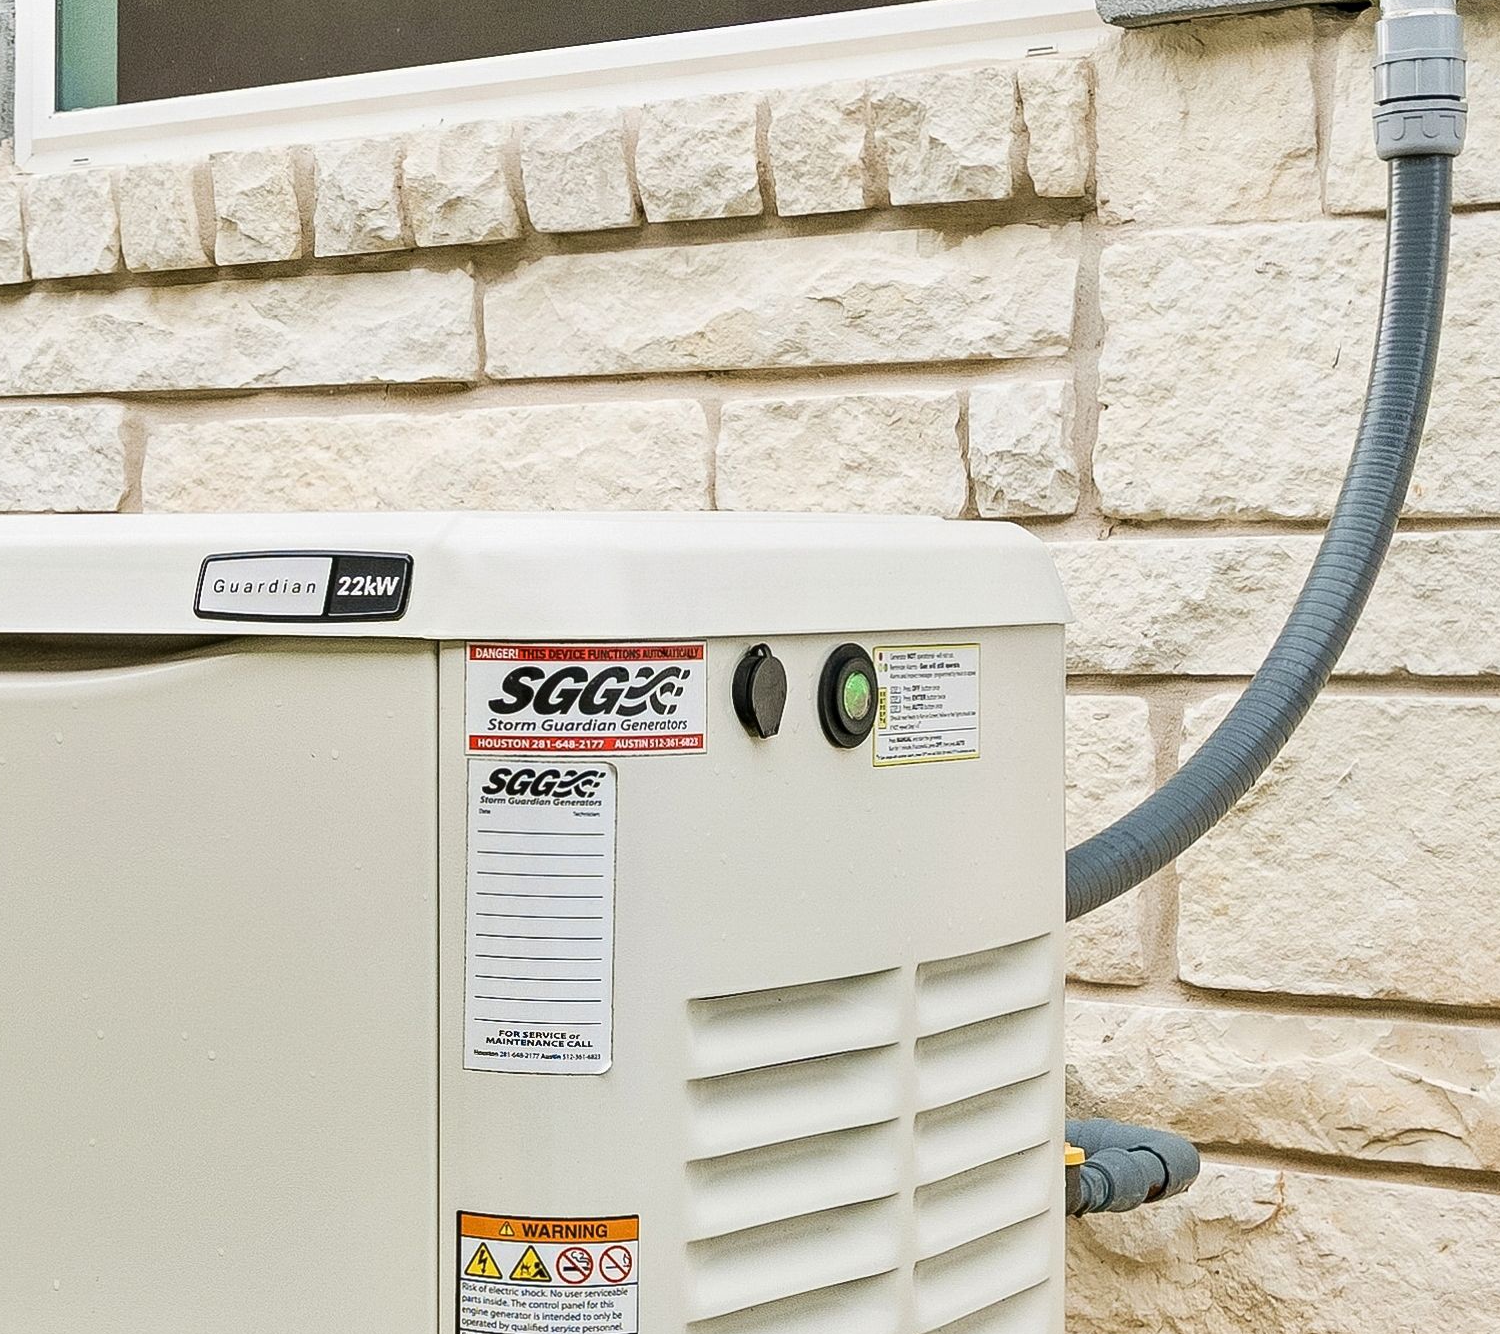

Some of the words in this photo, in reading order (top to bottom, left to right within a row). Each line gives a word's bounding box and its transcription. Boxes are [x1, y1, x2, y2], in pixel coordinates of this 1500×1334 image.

[213, 580, 316, 594] Guardian
[337, 576, 399, 596] 22kW
[475, 648, 518, 659] DANGER!
[520, 649, 547, 660] THIS
[550, 649, 586, 660] DEVICE
[588, 649, 640, 659] FUNCTIONS
[643, 648, 699, 659] AUTOMATICALLY
[488, 718, 536, 732] Storm
[541, 718, 616, 732] Guardian
[621, 718, 687, 731] Generators
[477, 738, 529, 748] HOUSTON
[531, 738, 604, 748] 281-648-2177
[615, 738, 648, 748] AUSTIN
[649, 738, 698, 748] 512-361-6823
[480, 796, 506, 804] Storm
[508, 797, 550, 805] Guardian
[553, 798, 601, 806] Generators
[499, 1030, 520, 1038] FOR
[522, 1031, 566, 1039] SERVICE
[486, 1038, 564, 1047] MAINTENANCE
[567, 1039, 593, 1048] CALL
[522, 1223, 607, 1238] WARNING
[462, 1283, 477, 1292] Risk
[479, 1285, 487, 1293] of
[489, 1286, 518, 1297] electric
[521, 1288, 547, 1297] shock.
[550, 1290, 562, 1298] No
[585, 1288, 628, 1298] serviceable
[462, 1295, 481, 1304] parts
[483, 1297, 509, 1307] inside.
[511, 1299, 526, 1308] The
[529, 1301, 559, 1309] control
[562, 1300, 585, 1310] panel
[587, 1300, 598, 1308] for
[462, 1307, 488, 1317] engine
[491, 1310, 531, 1321] generator
[534, 1312, 540, 1320] is
[542, 1312, 580, 1321] intended
[593, 1312, 611, 1322] only
[462, 1318, 496, 1328] operated
[500, 1321, 508, 1331] by
[511, 1323, 548, 1334] qualified
[583, 1323, 623, 1333] personnel.
